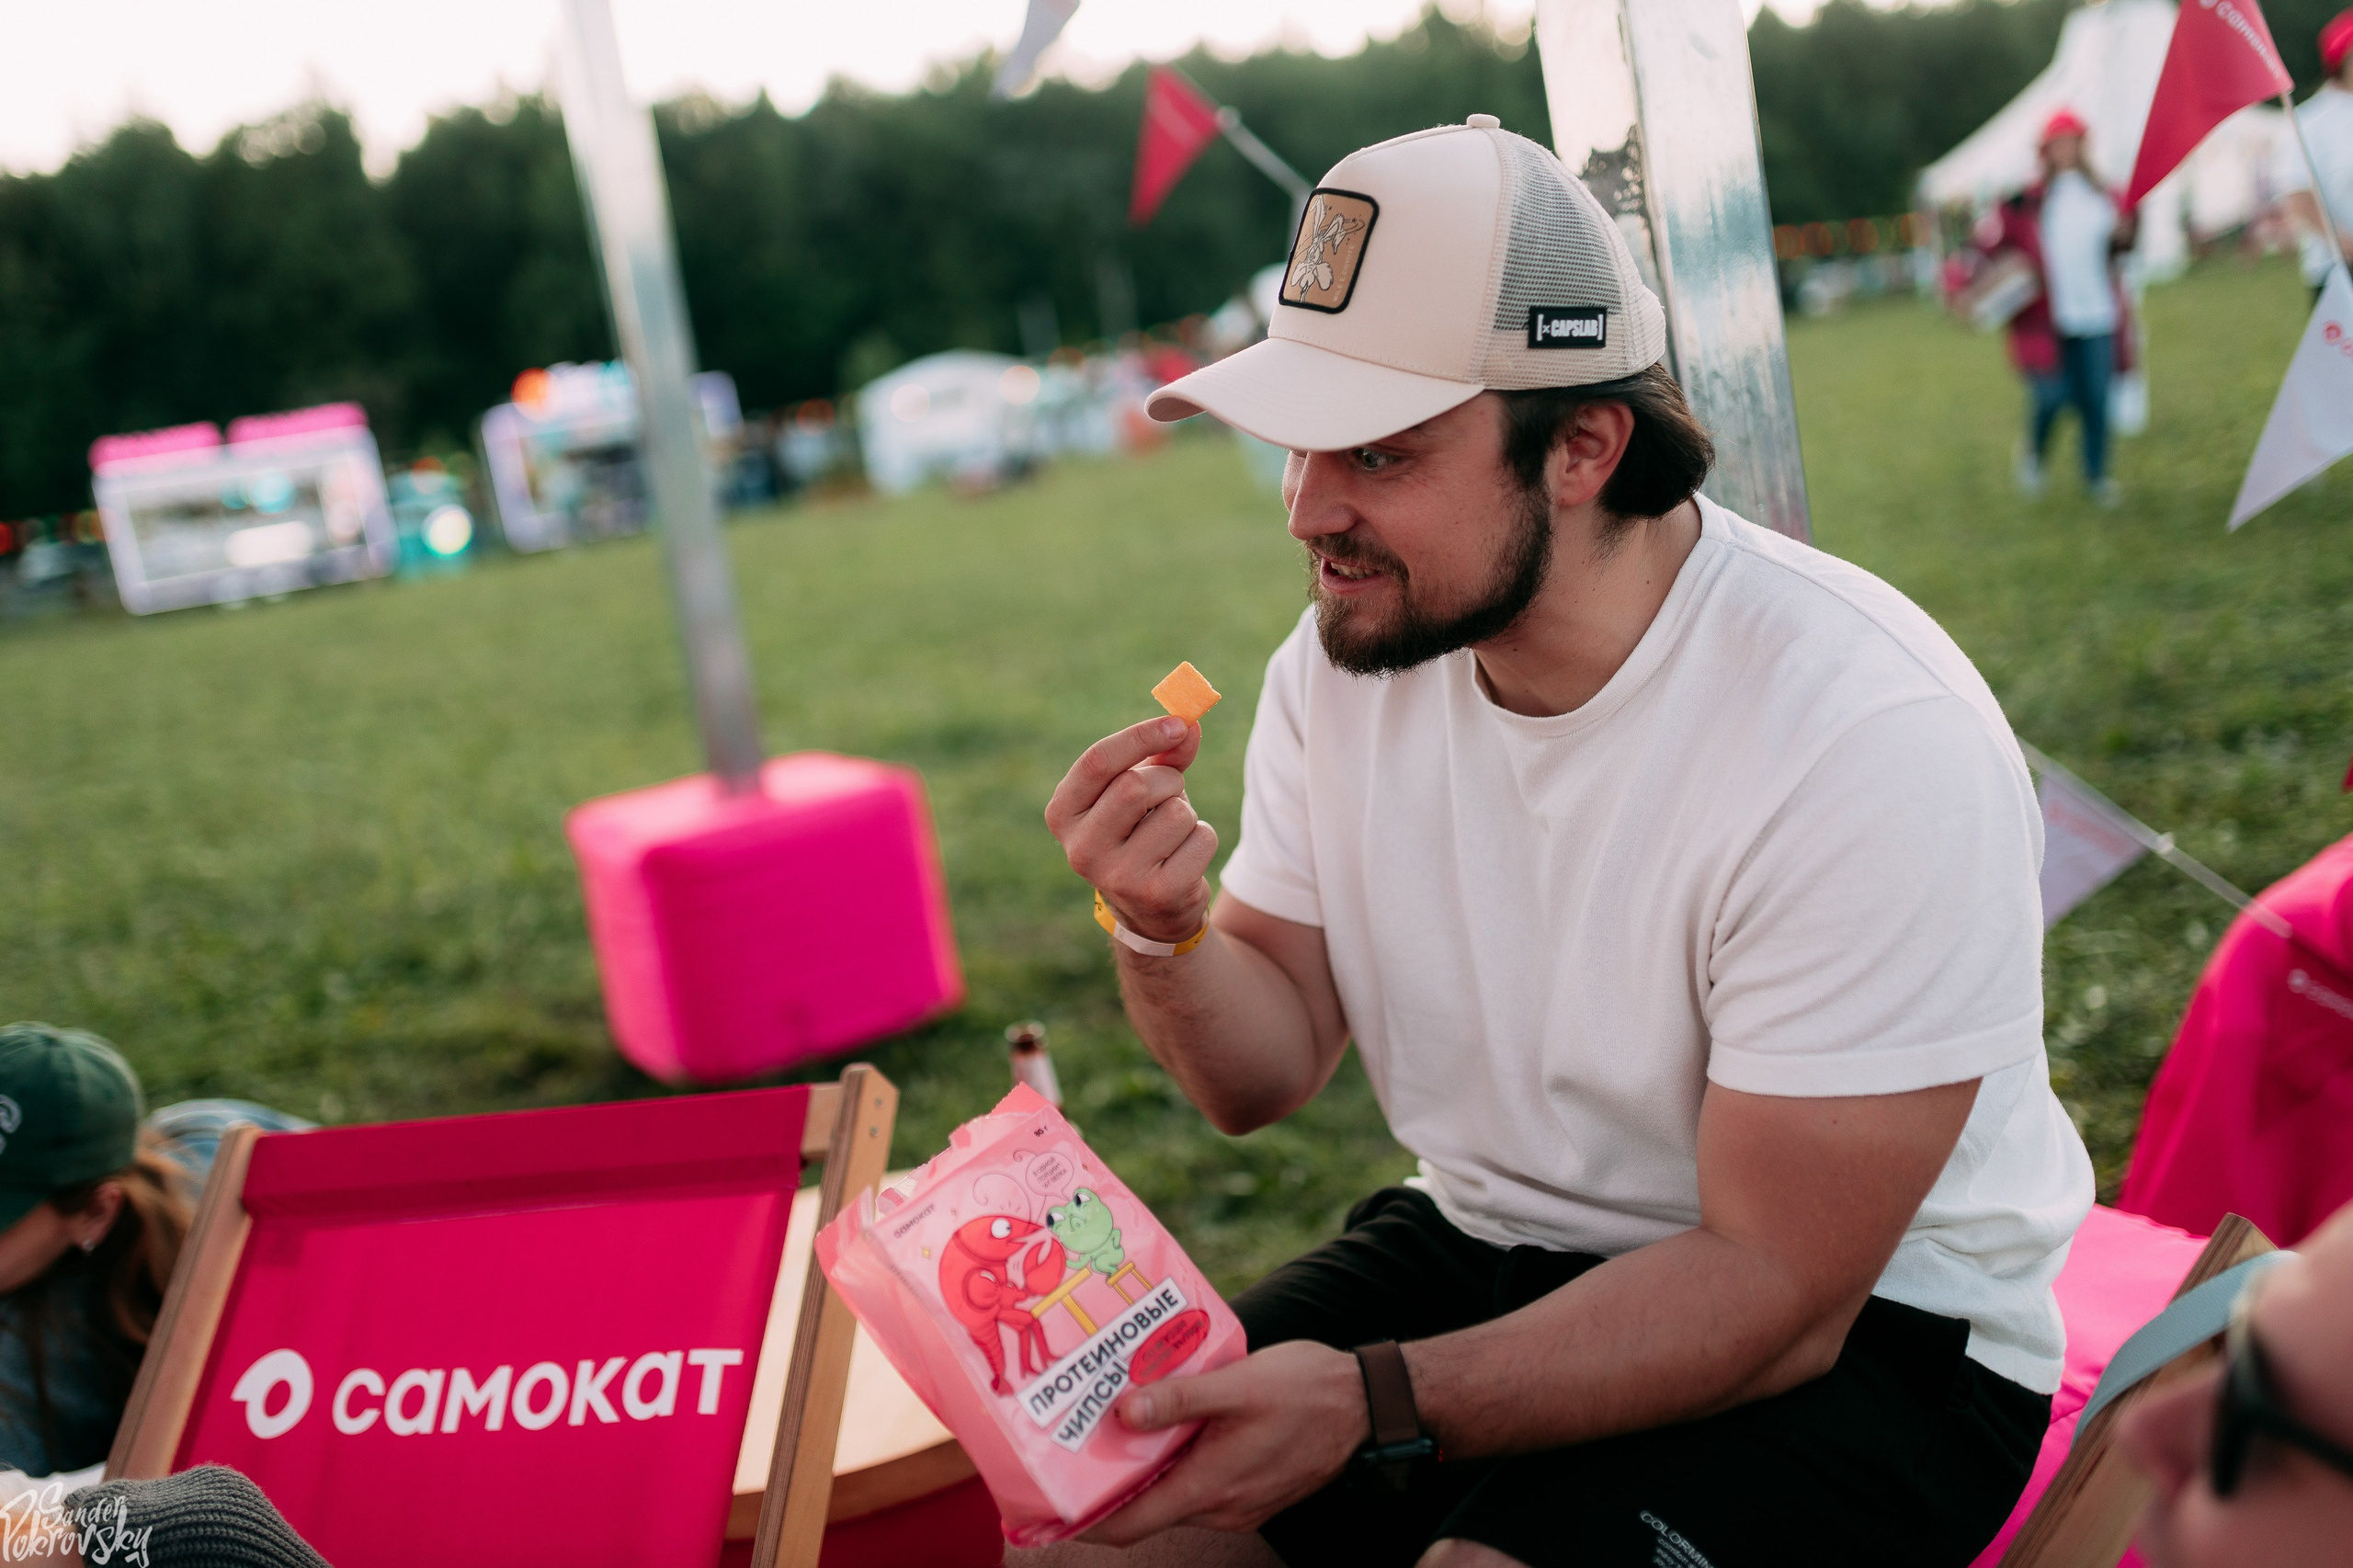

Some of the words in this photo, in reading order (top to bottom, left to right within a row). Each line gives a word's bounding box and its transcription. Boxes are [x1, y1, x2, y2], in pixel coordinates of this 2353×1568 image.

[331, 1348, 745, 1436] самокат
[1029, 1289, 1179, 1416] ПРОТЕИНОВЫЕ
[1058, 1361, 1128, 1441] ЧИПСЫ
